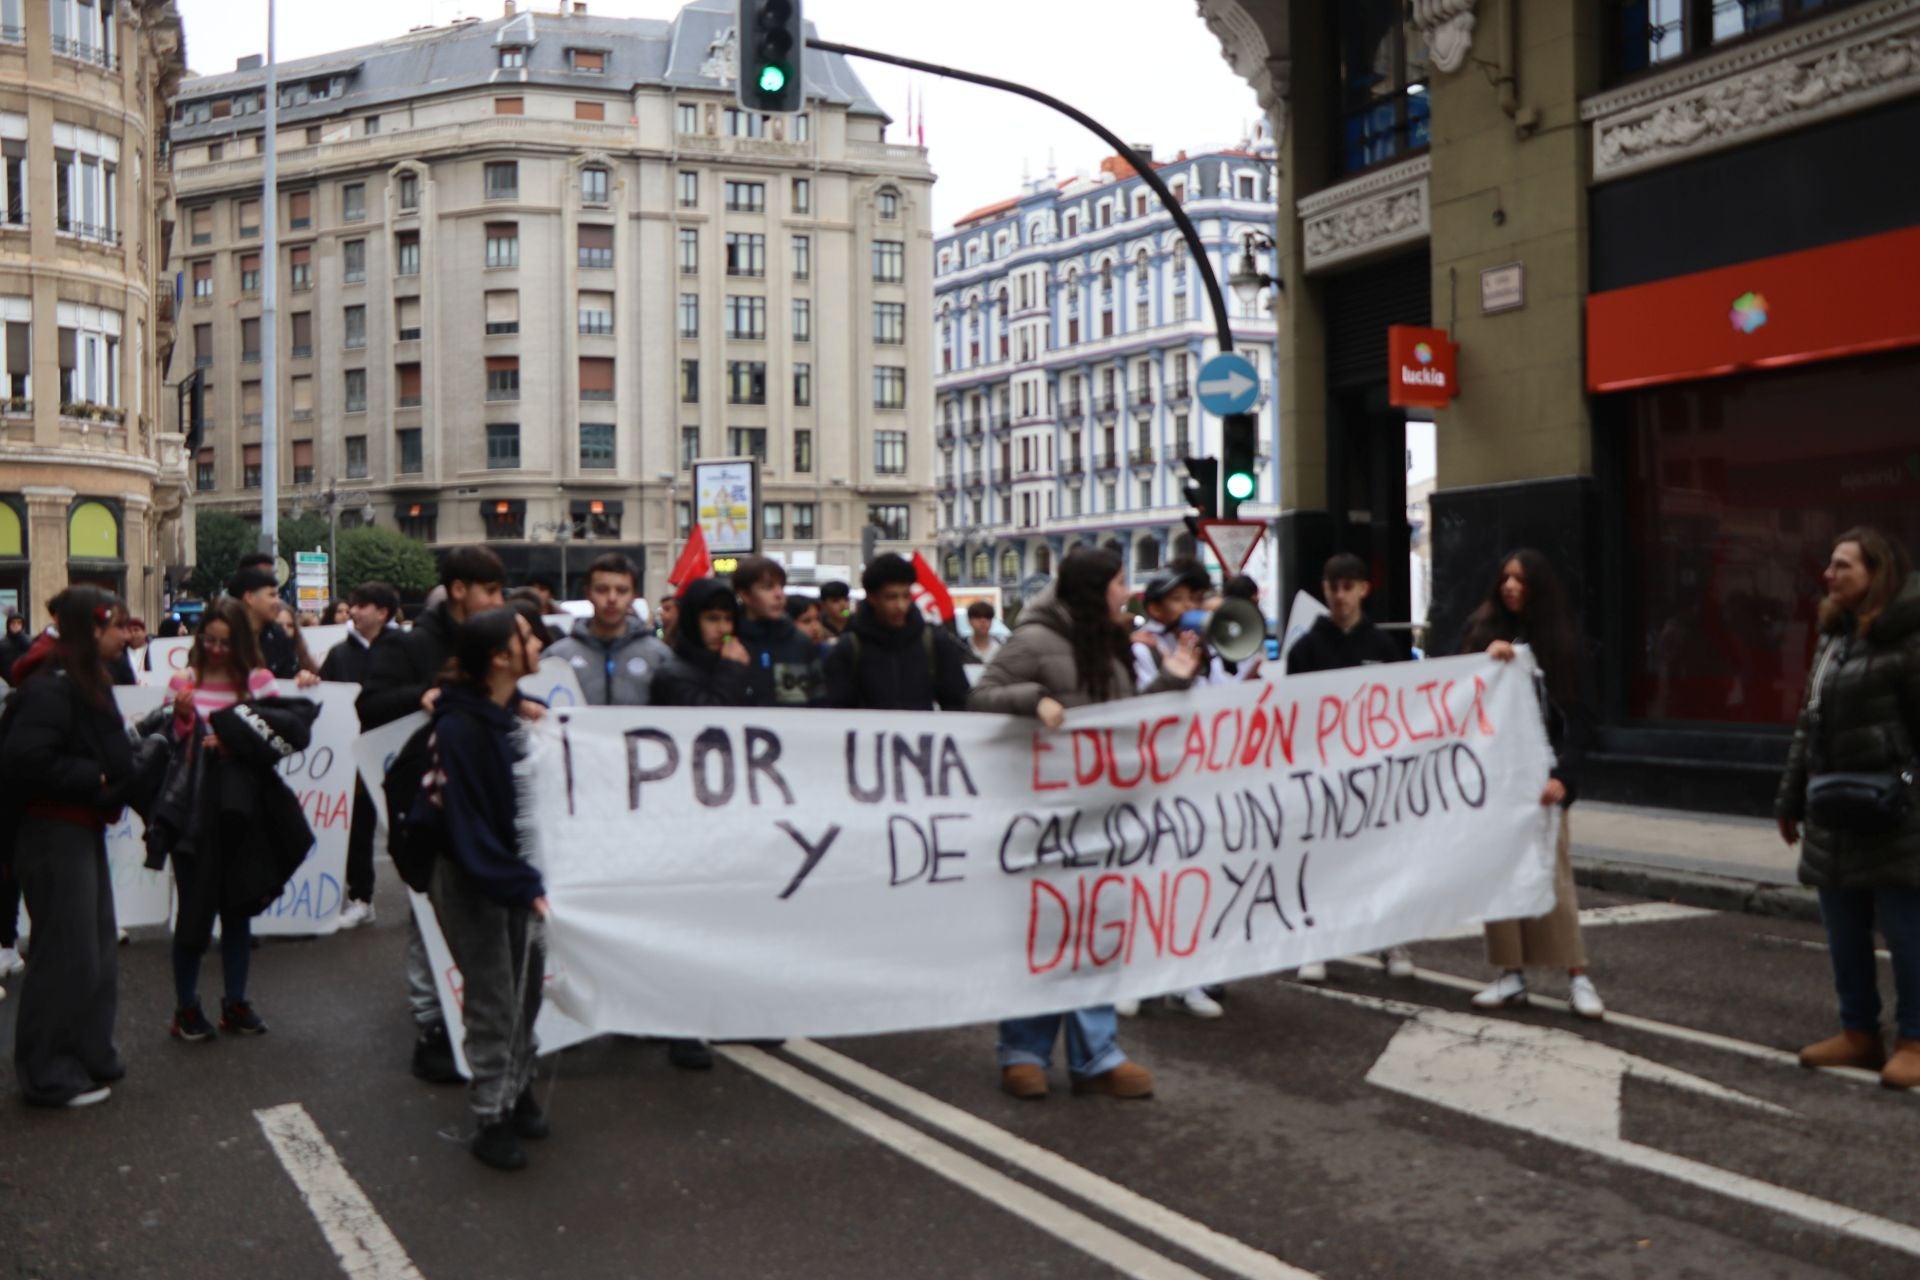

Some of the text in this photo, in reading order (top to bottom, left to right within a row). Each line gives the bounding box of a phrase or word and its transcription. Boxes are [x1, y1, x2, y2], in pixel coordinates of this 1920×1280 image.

[1402, 366, 1446, 386] luckia
[846, 728, 979, 804] UNA
[1031, 682, 1300, 792] EDUCACIÓN
[1316, 674, 1496, 766] PÚBLICA
[773, 742, 1488, 900] Y DE CALIDAD UN INSTITUTO
[1026, 852, 1318, 976] DIGNO YA!
